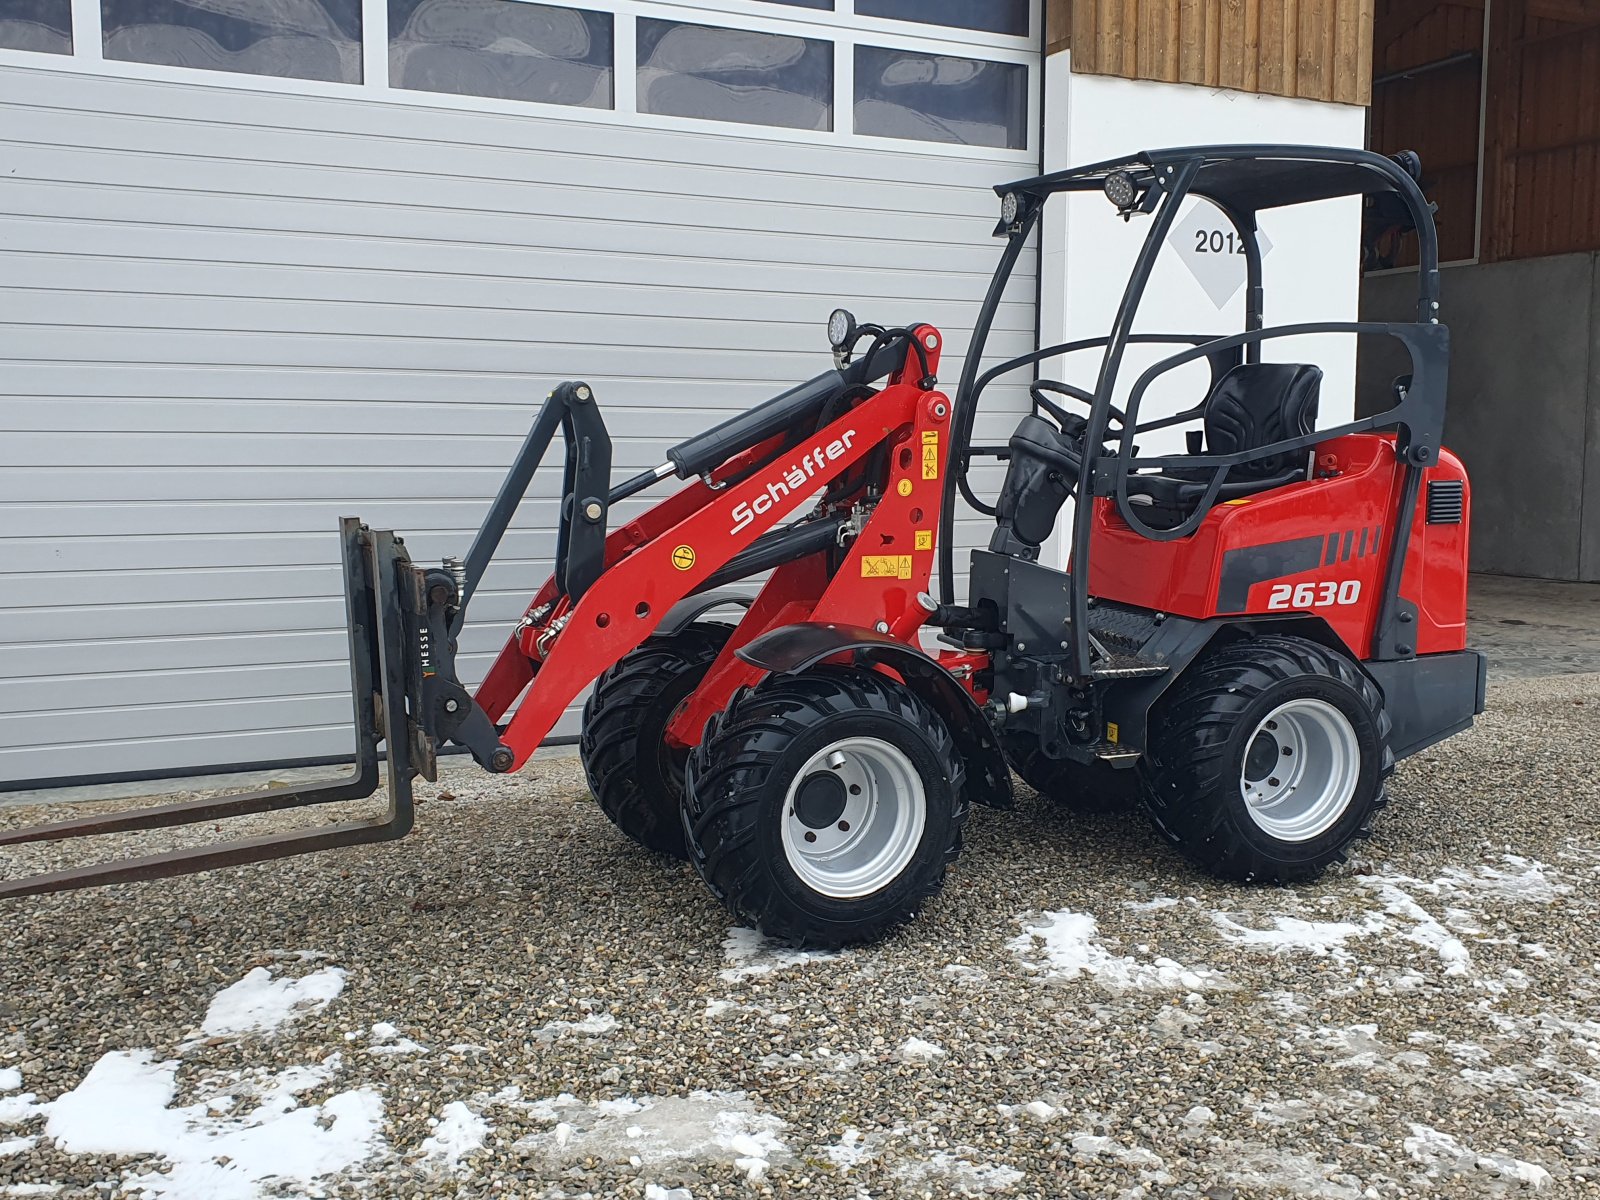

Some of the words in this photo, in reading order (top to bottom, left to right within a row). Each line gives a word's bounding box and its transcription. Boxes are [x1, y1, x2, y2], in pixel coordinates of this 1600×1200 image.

[730, 429, 856, 536] Schäffer
[1267, 580, 1362, 610] 2630
[419, 627, 430, 667] HESSE
